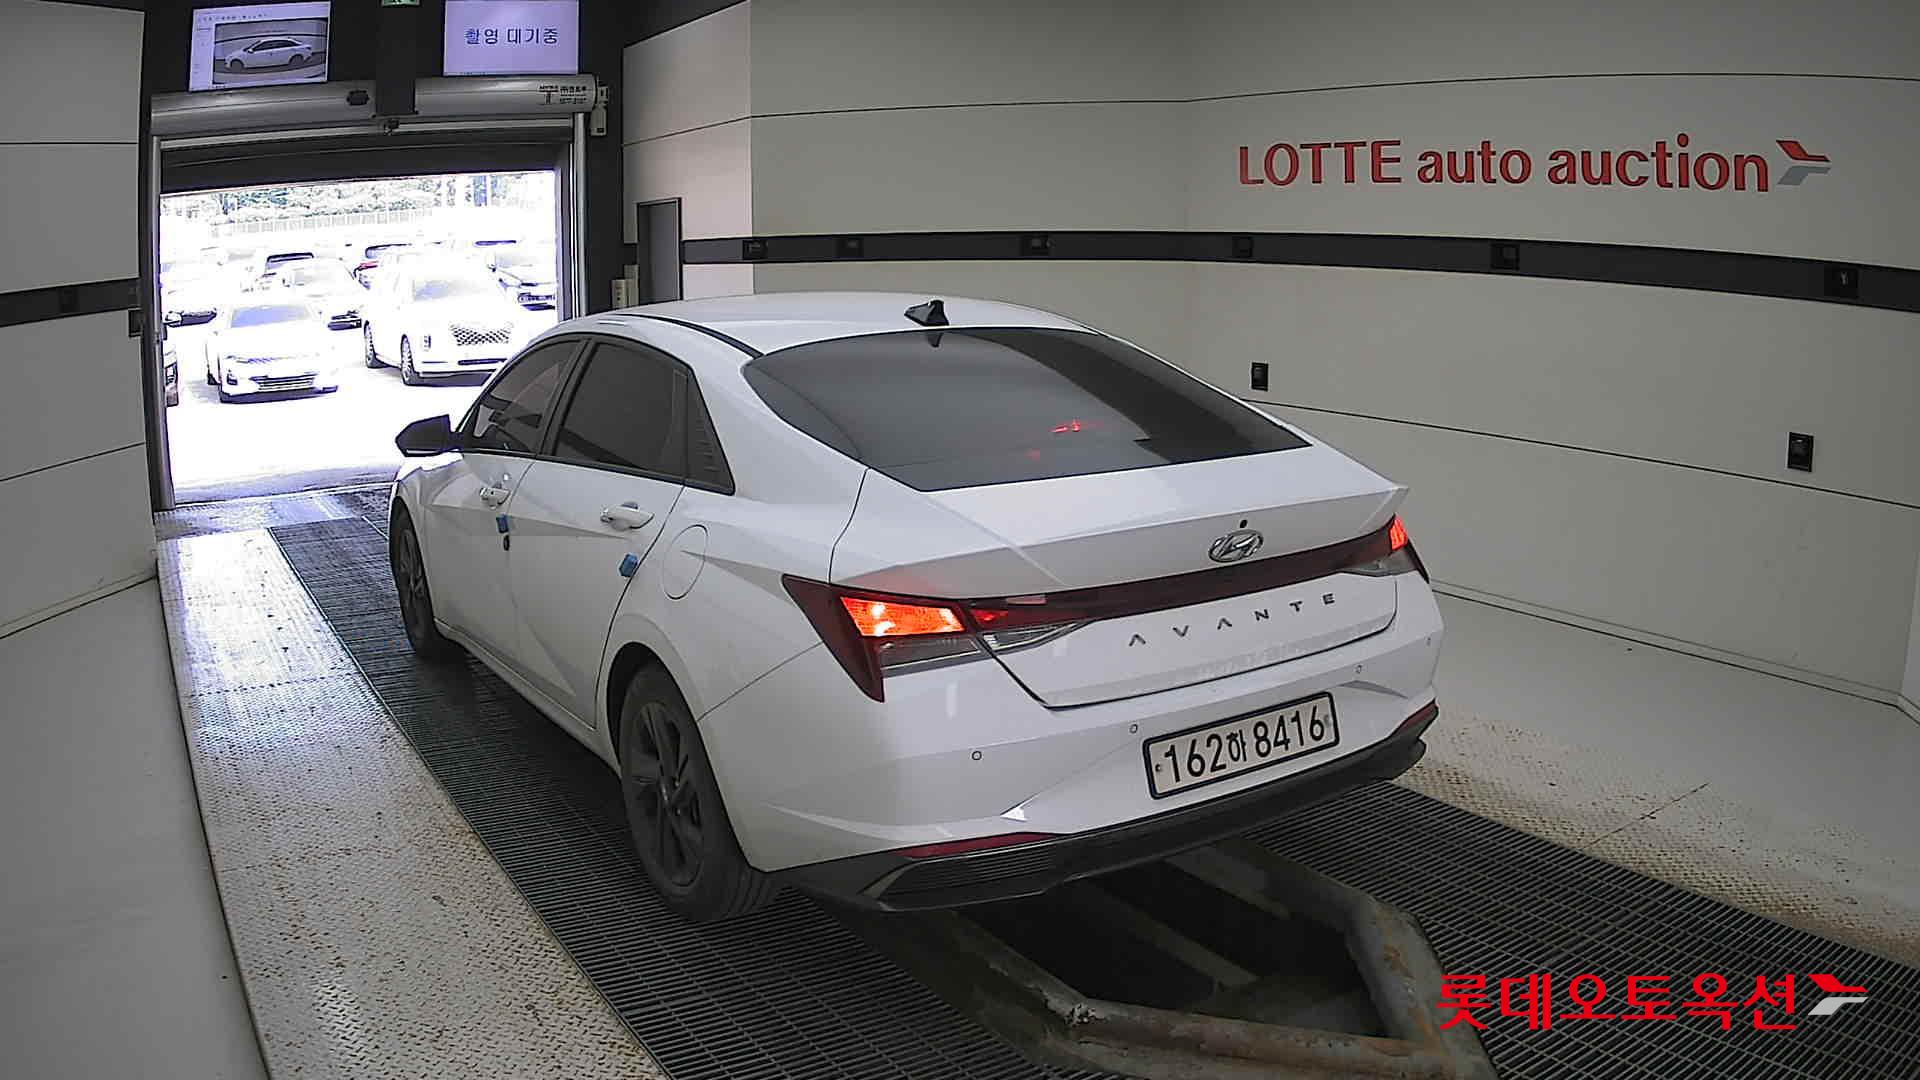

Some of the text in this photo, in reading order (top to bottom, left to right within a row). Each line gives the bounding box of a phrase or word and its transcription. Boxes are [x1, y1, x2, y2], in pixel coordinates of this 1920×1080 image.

[464, 27, 559, 45] 촬영 대기중
[1239, 133, 1770, 192] LOTTE auto auction
[1129, 593, 1335, 646] AVANTE
